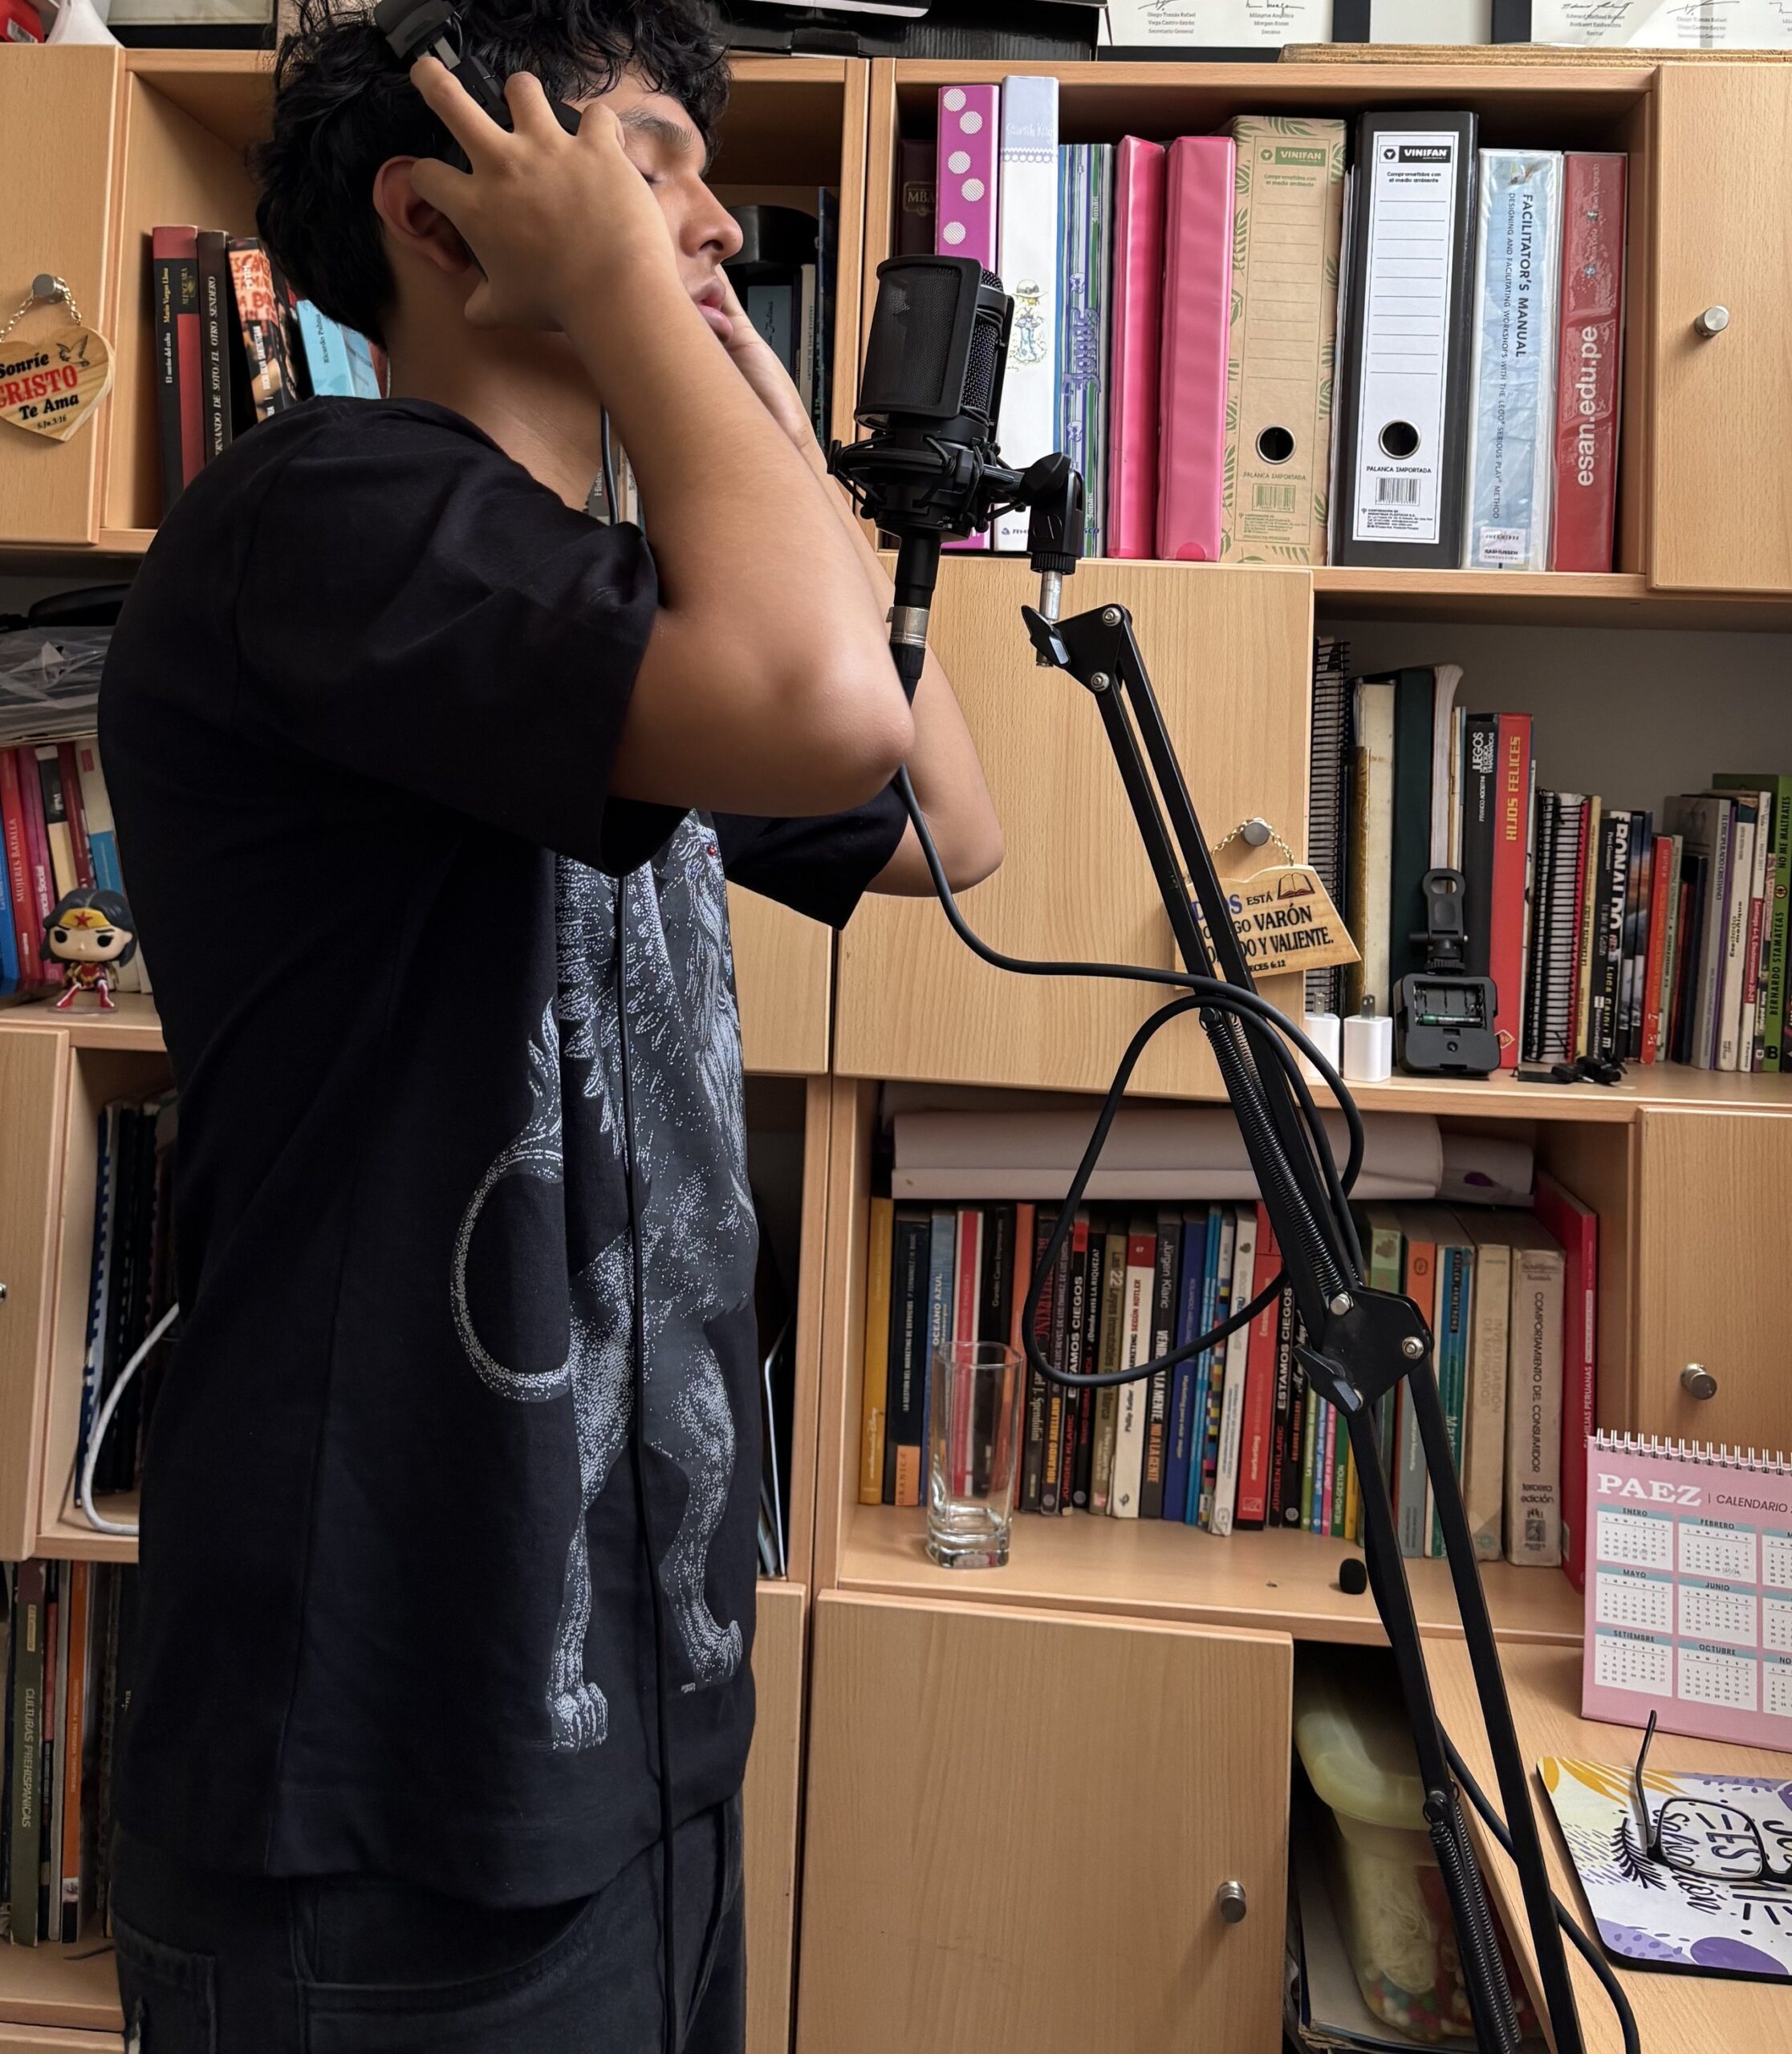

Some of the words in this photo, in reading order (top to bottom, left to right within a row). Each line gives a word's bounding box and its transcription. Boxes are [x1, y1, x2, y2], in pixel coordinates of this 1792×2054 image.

[1280, 150, 1322, 160] VINIFAN
[1404, 148, 1447, 157] VINIFAN
[1518, 194, 1534, 291] FACILITATOR'S
[162, 285, 170, 304] Vargas
[208, 277, 217, 318] SENDERO
[1504, 258, 1513, 307] FACILITATING
[209, 322, 217, 346] OTRO
[1515, 298, 1529, 358] MANUAL
[319, 336, 330, 363] Ricardo
[19, 405, 39, 421] Te
[43, 394, 79, 414] Ama
[213, 395, 221, 408] DE
[1575, 326, 1603, 487] esan.edu.pe
[1493, 485, 1501, 519] METHOD
[1472, 732, 1484, 770] JUEGOS
[1508, 736, 1521, 793] FELICES
[1506, 798, 1518, 841] HIJOS
[9, 818, 21, 859] BATALLA
[1719, 822, 1728, 865] DISCIPULADO
[1778, 842, 1787, 854] ME
[1777, 857, 1786, 869] NO
[13, 860, 25, 903] MUJERES
[35, 866, 48, 893] Social
[1717, 867, 1725, 900] CRISTIANO
[1247, 891, 1273, 905] ESTÁ
[1254, 903, 1313, 932] VARÓN
[1753, 901, 1762, 927] Santiago
[1258, 937, 1267, 956] Y
[1270, 927, 1334, 953] VALIENTE.
[1772, 912, 1784, 964] STAMATEAS
[1270, 960, 1286, 968] 6:12
[1770, 968, 1781, 1016] BERNARDO
[1090, 1248, 1099, 1285] RIQUEZA?
[1110, 1269, 1124, 1286] 22
[933, 1273, 943, 1300] AZUL
[1089, 1286, 1097, 1297] LA
[1106, 1288, 1119, 1314] Leyes
[1160, 1278, 1172, 1309] Klaric
[1072, 1277, 1083, 1329] CIEGOS
[1281, 1288, 1293, 1341] CIEGOS
[1532, 1292, 1544, 1382] COMPORTAMIENTO
[1277, 1344, 1290, 1410] ESTAMOS
[1584, 1366, 1593, 1410] PERUANAS
[1533, 1385, 1542, 1401] DEL
[1050, 1398, 1060, 1441] ARELLANO
[1066, 1415, 1075, 1455] KLARIC
[1274, 1426, 1284, 1465] KLARIC
[1531, 1404, 1541, 1473] CONSUMIDOR
[1046, 1443, 1058, 1484] ROLANDO
[1148, 1456, 1160, 1483] GENTE
[1521, 1493, 1554, 1503] edición
[1522, 1483, 1553, 1492] tercera
[1596, 1472, 1702, 1507] PAEZ
[1716, 1494, 1788, 1513] CALENDARIO
[1622, 1508, 1648, 1517] ENERO
[1700, 1519, 1734, 1530] FEBRERO
[1623, 1569, 1646, 1579] MAYO
[1705, 1582, 1730, 1592] JUNIO
[1613, 1630, 1655, 1642] SETIEMBRE
[1699, 1643, 1736, 1656] OCTUBRE
[24, 1688, 35, 1741] CULTURAS
